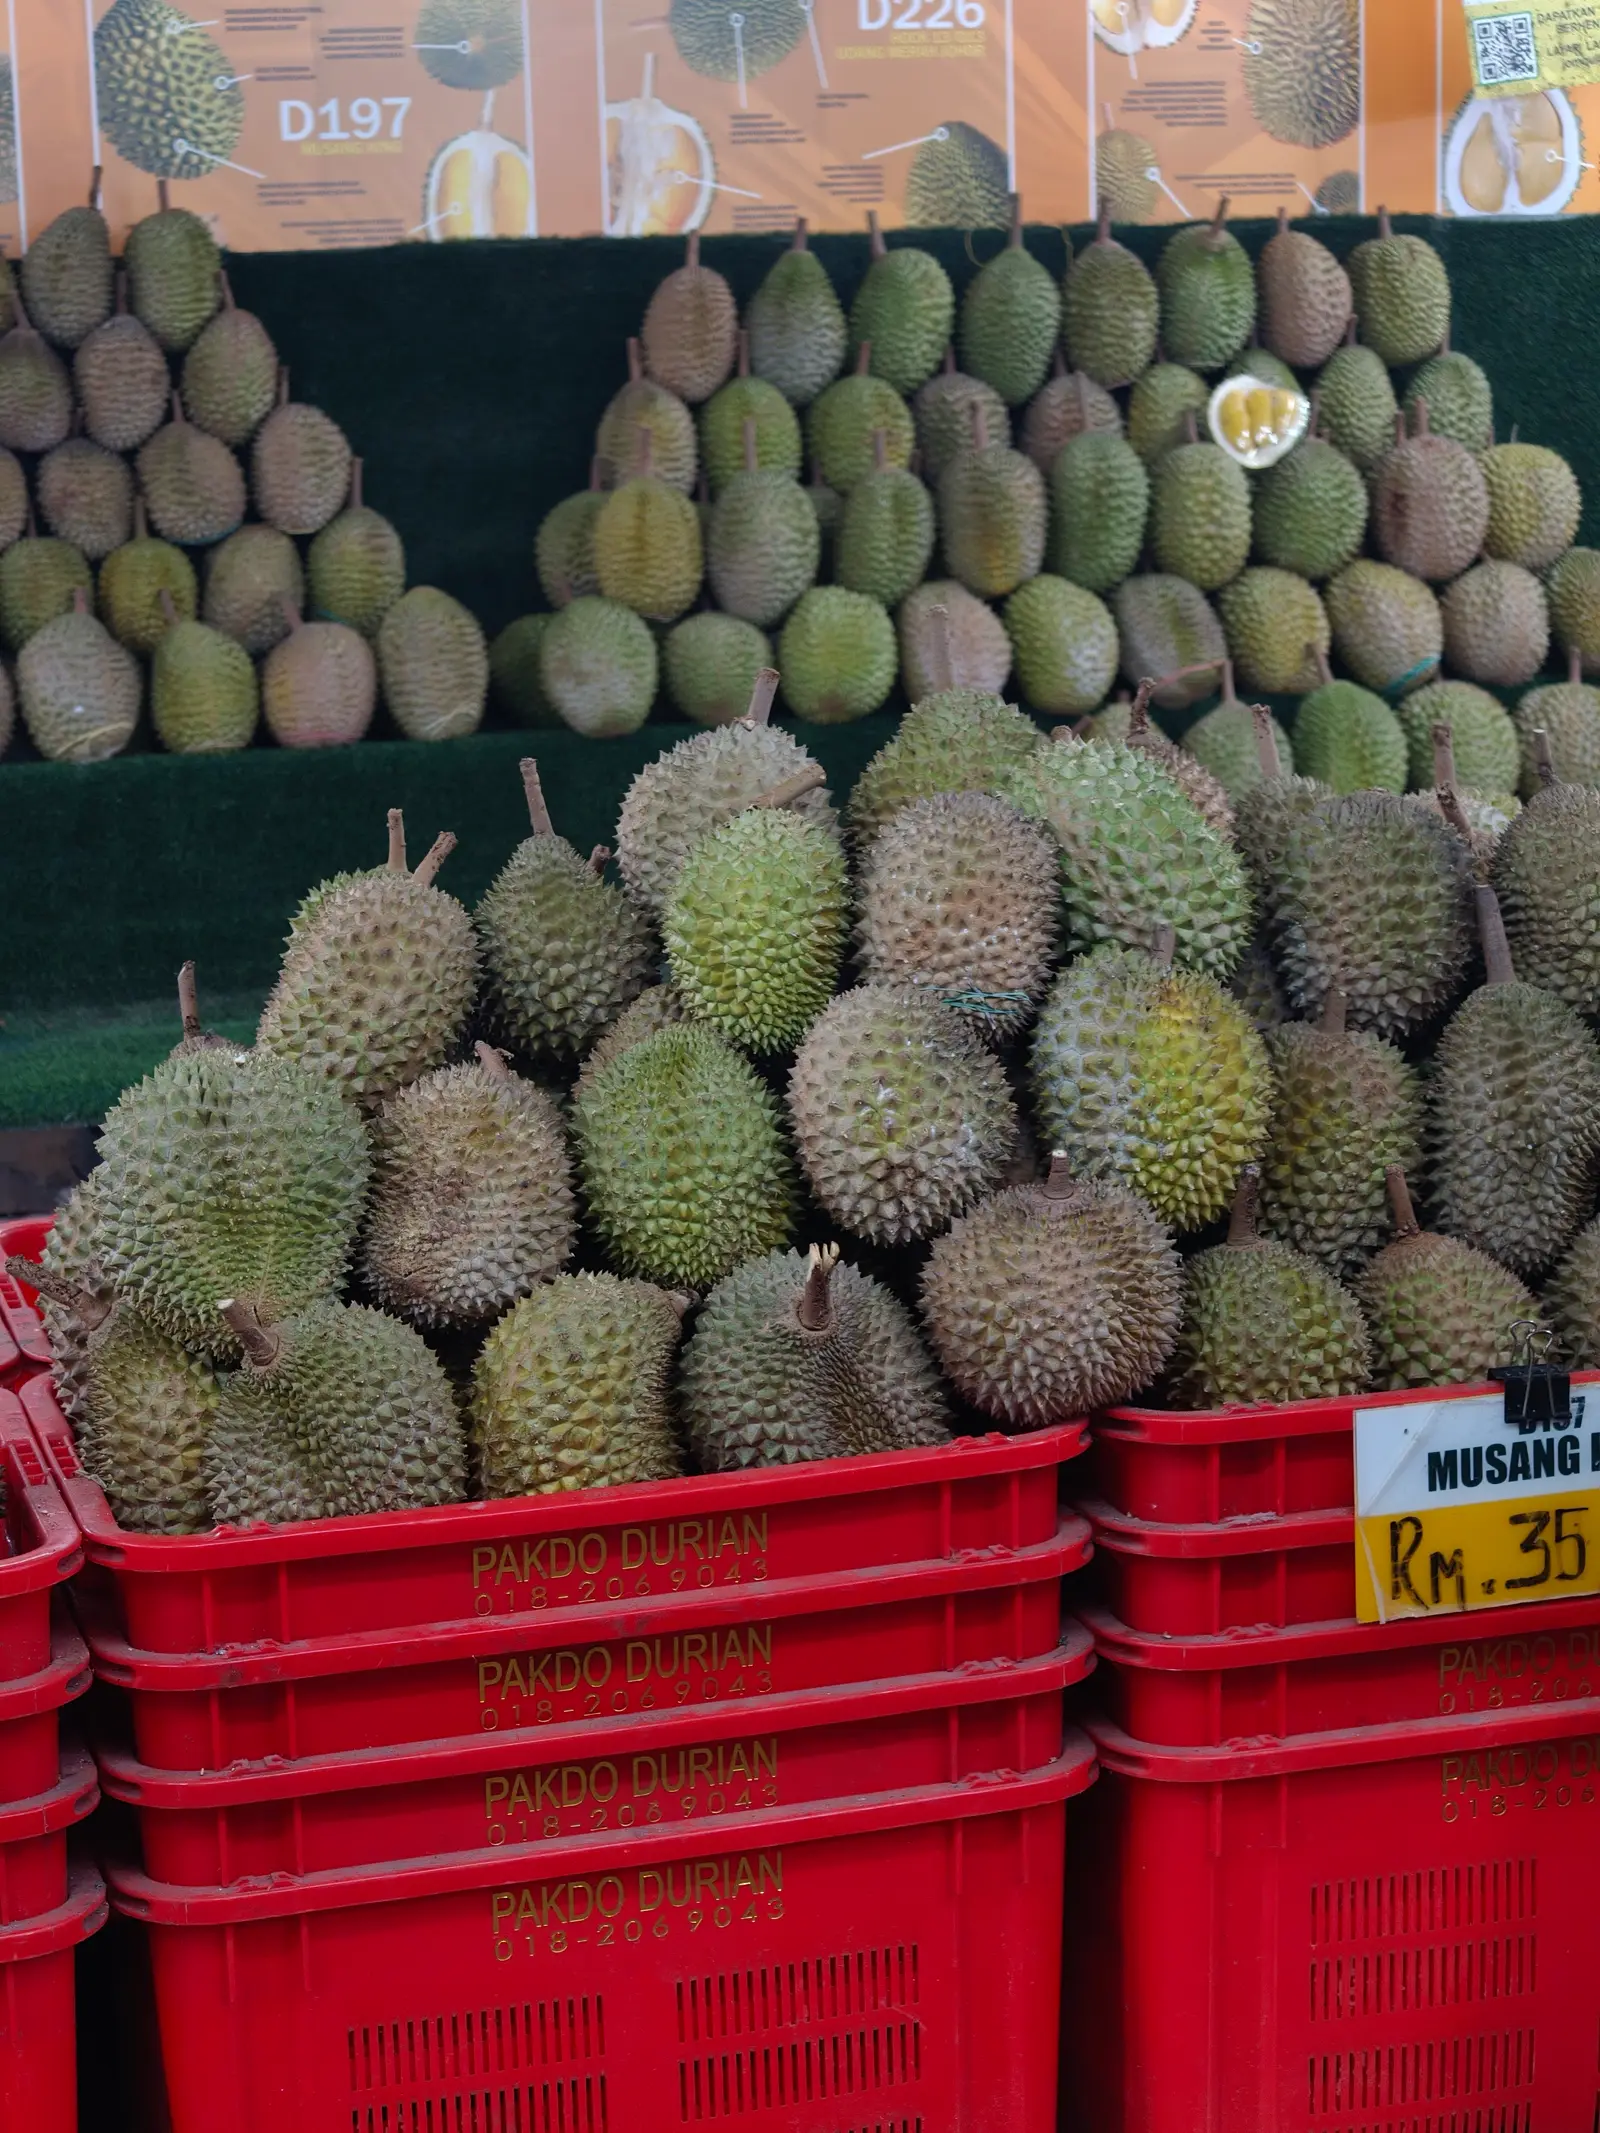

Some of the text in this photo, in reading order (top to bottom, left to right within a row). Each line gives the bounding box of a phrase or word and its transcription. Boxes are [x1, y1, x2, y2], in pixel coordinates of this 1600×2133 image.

[858, 0, 985, 29] D226
[279, 97, 411, 140] D197
[1428, 1434, 1580, 1492] MUSANG
[473, 1513, 767, 1588] PAKDO DURIAN
[478, 1625, 772, 1703] PAKDO DURIAN
[1439, 1636, 1555, 1687] PAKDO
[485, 1738, 778, 1819] PAKDO DURIAN
[1441, 1745, 1559, 1796] PAKDO
[492, 1851, 783, 1934] PAKDO DURIAN
